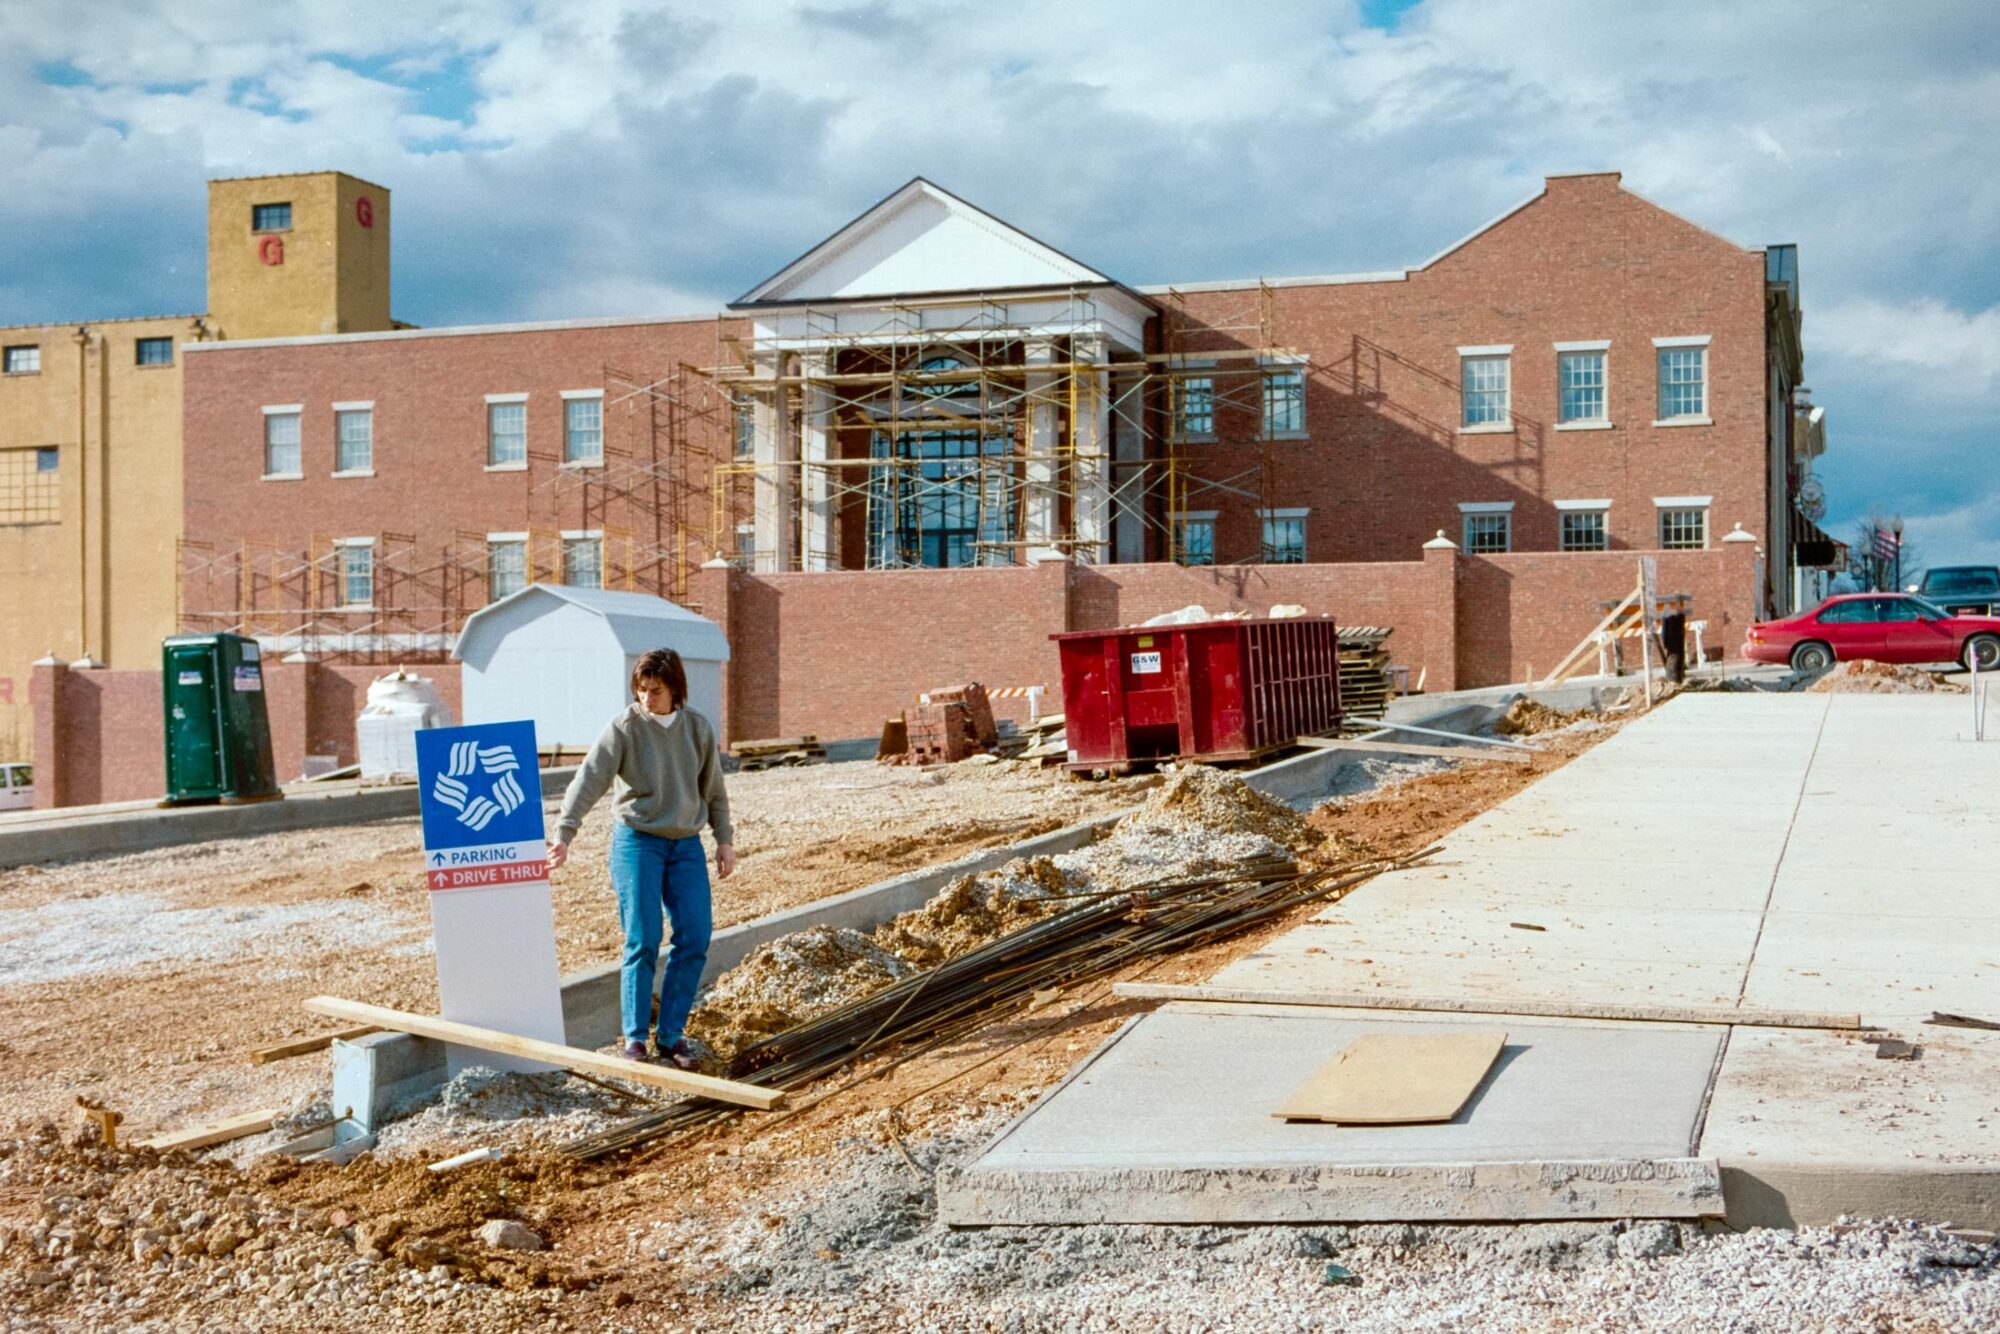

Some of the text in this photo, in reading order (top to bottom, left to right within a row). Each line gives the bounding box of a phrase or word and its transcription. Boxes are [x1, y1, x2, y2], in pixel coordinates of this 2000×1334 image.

[356, 196, 373, 228] G
[258, 234, 284, 266] G
[451, 847, 517, 865] PARKING
[452, 864, 544, 886] DRIVE THRU
